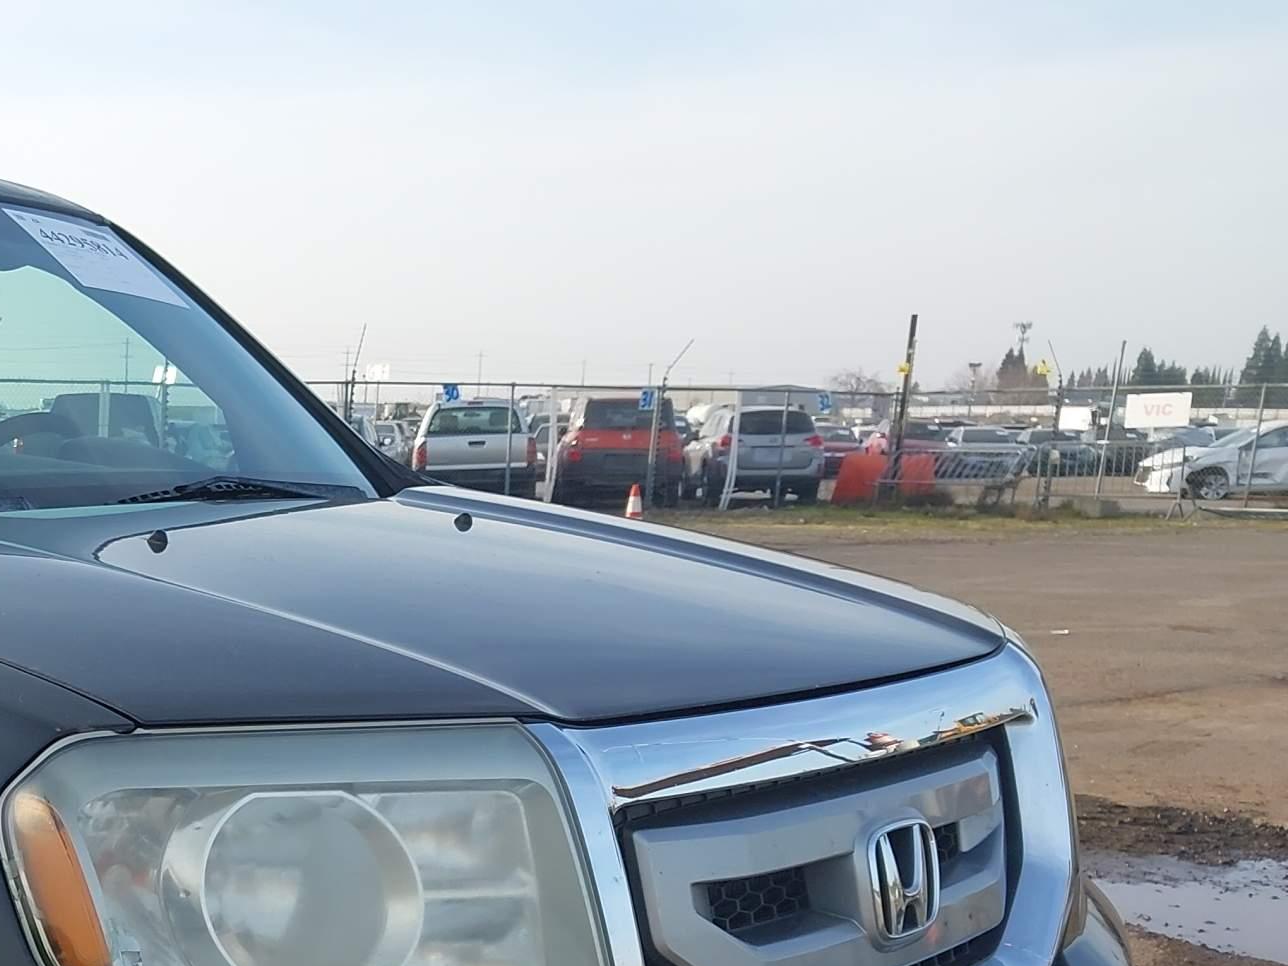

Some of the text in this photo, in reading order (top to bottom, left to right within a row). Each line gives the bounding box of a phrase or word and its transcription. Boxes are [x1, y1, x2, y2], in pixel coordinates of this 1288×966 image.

[442, 384, 459, 403] 30
[640, 390, 655, 409] 31
[1143, 402, 1174, 417] VIC
